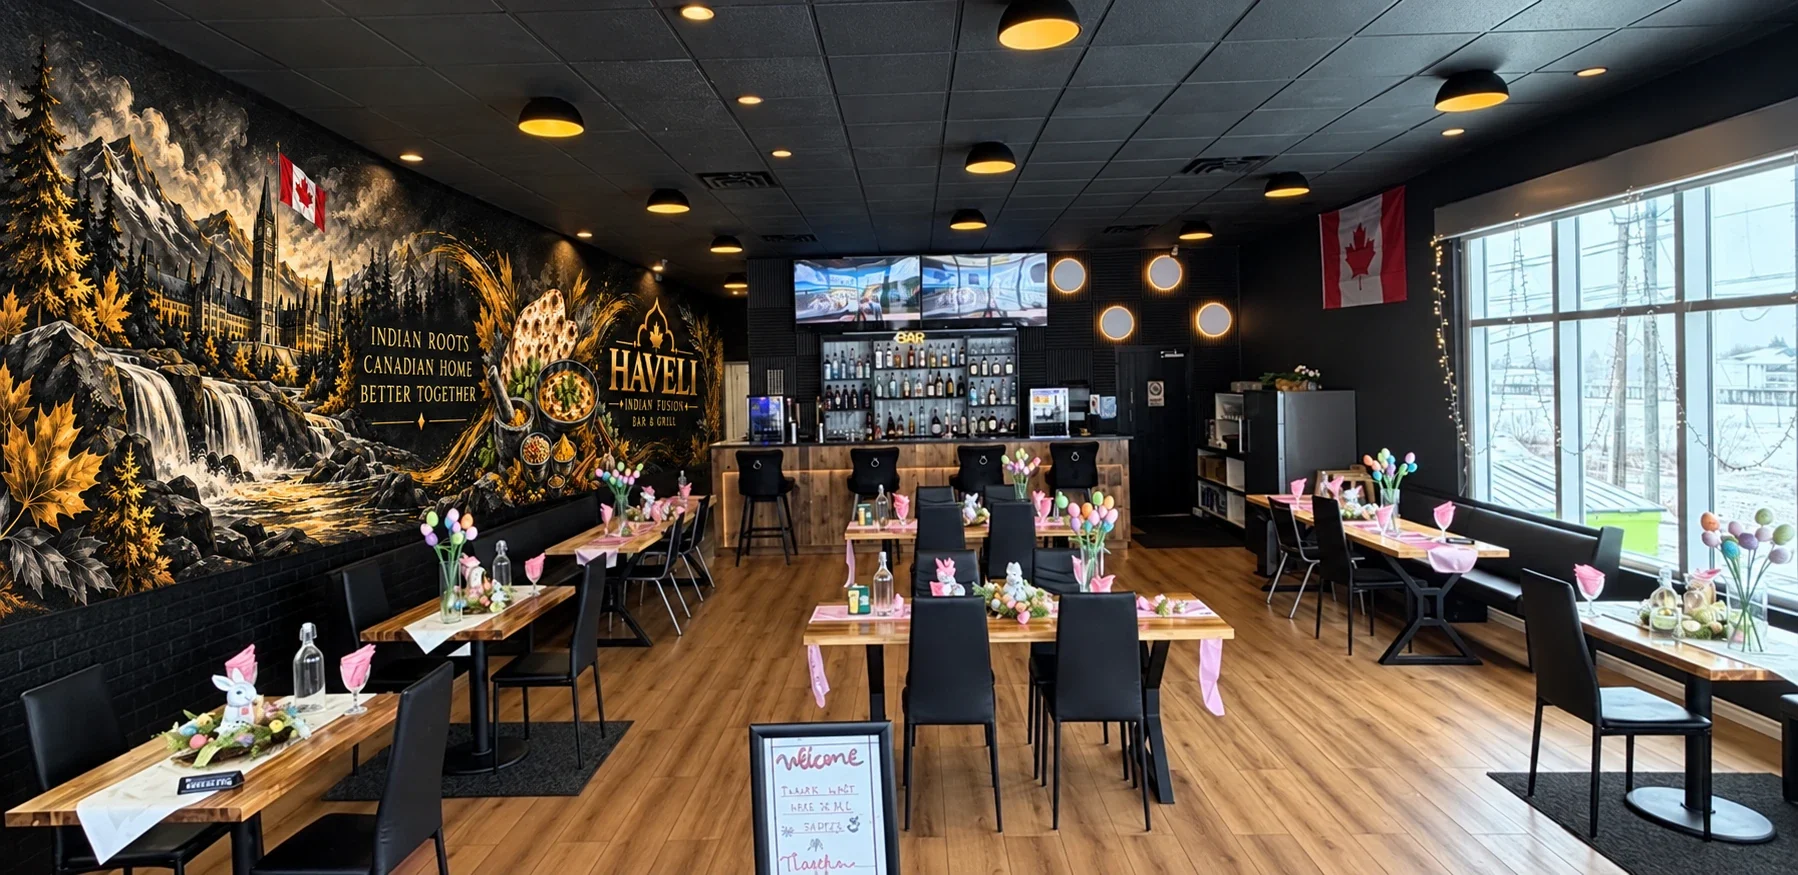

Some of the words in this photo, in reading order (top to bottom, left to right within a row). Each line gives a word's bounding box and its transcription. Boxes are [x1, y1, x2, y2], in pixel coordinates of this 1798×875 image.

[371, 326, 421, 348] INDIAN
[428, 332, 469, 352] ROOTS
[895, 331, 925, 344] BAR
[363, 355, 434, 376] CANADIAN
[440, 359, 473, 377] HOME
[609, 347, 698, 396] HAVELI
[360, 384, 411, 403] BETTER
[417, 385, 476, 403] TOGETHER
[625, 398, 653, 411] INDIAN
[657, 399, 684, 412] FUSION
[632, 416, 646, 427] BAR
[649, 417, 654, 427] &
[657, 416, 676, 427] GRILL
